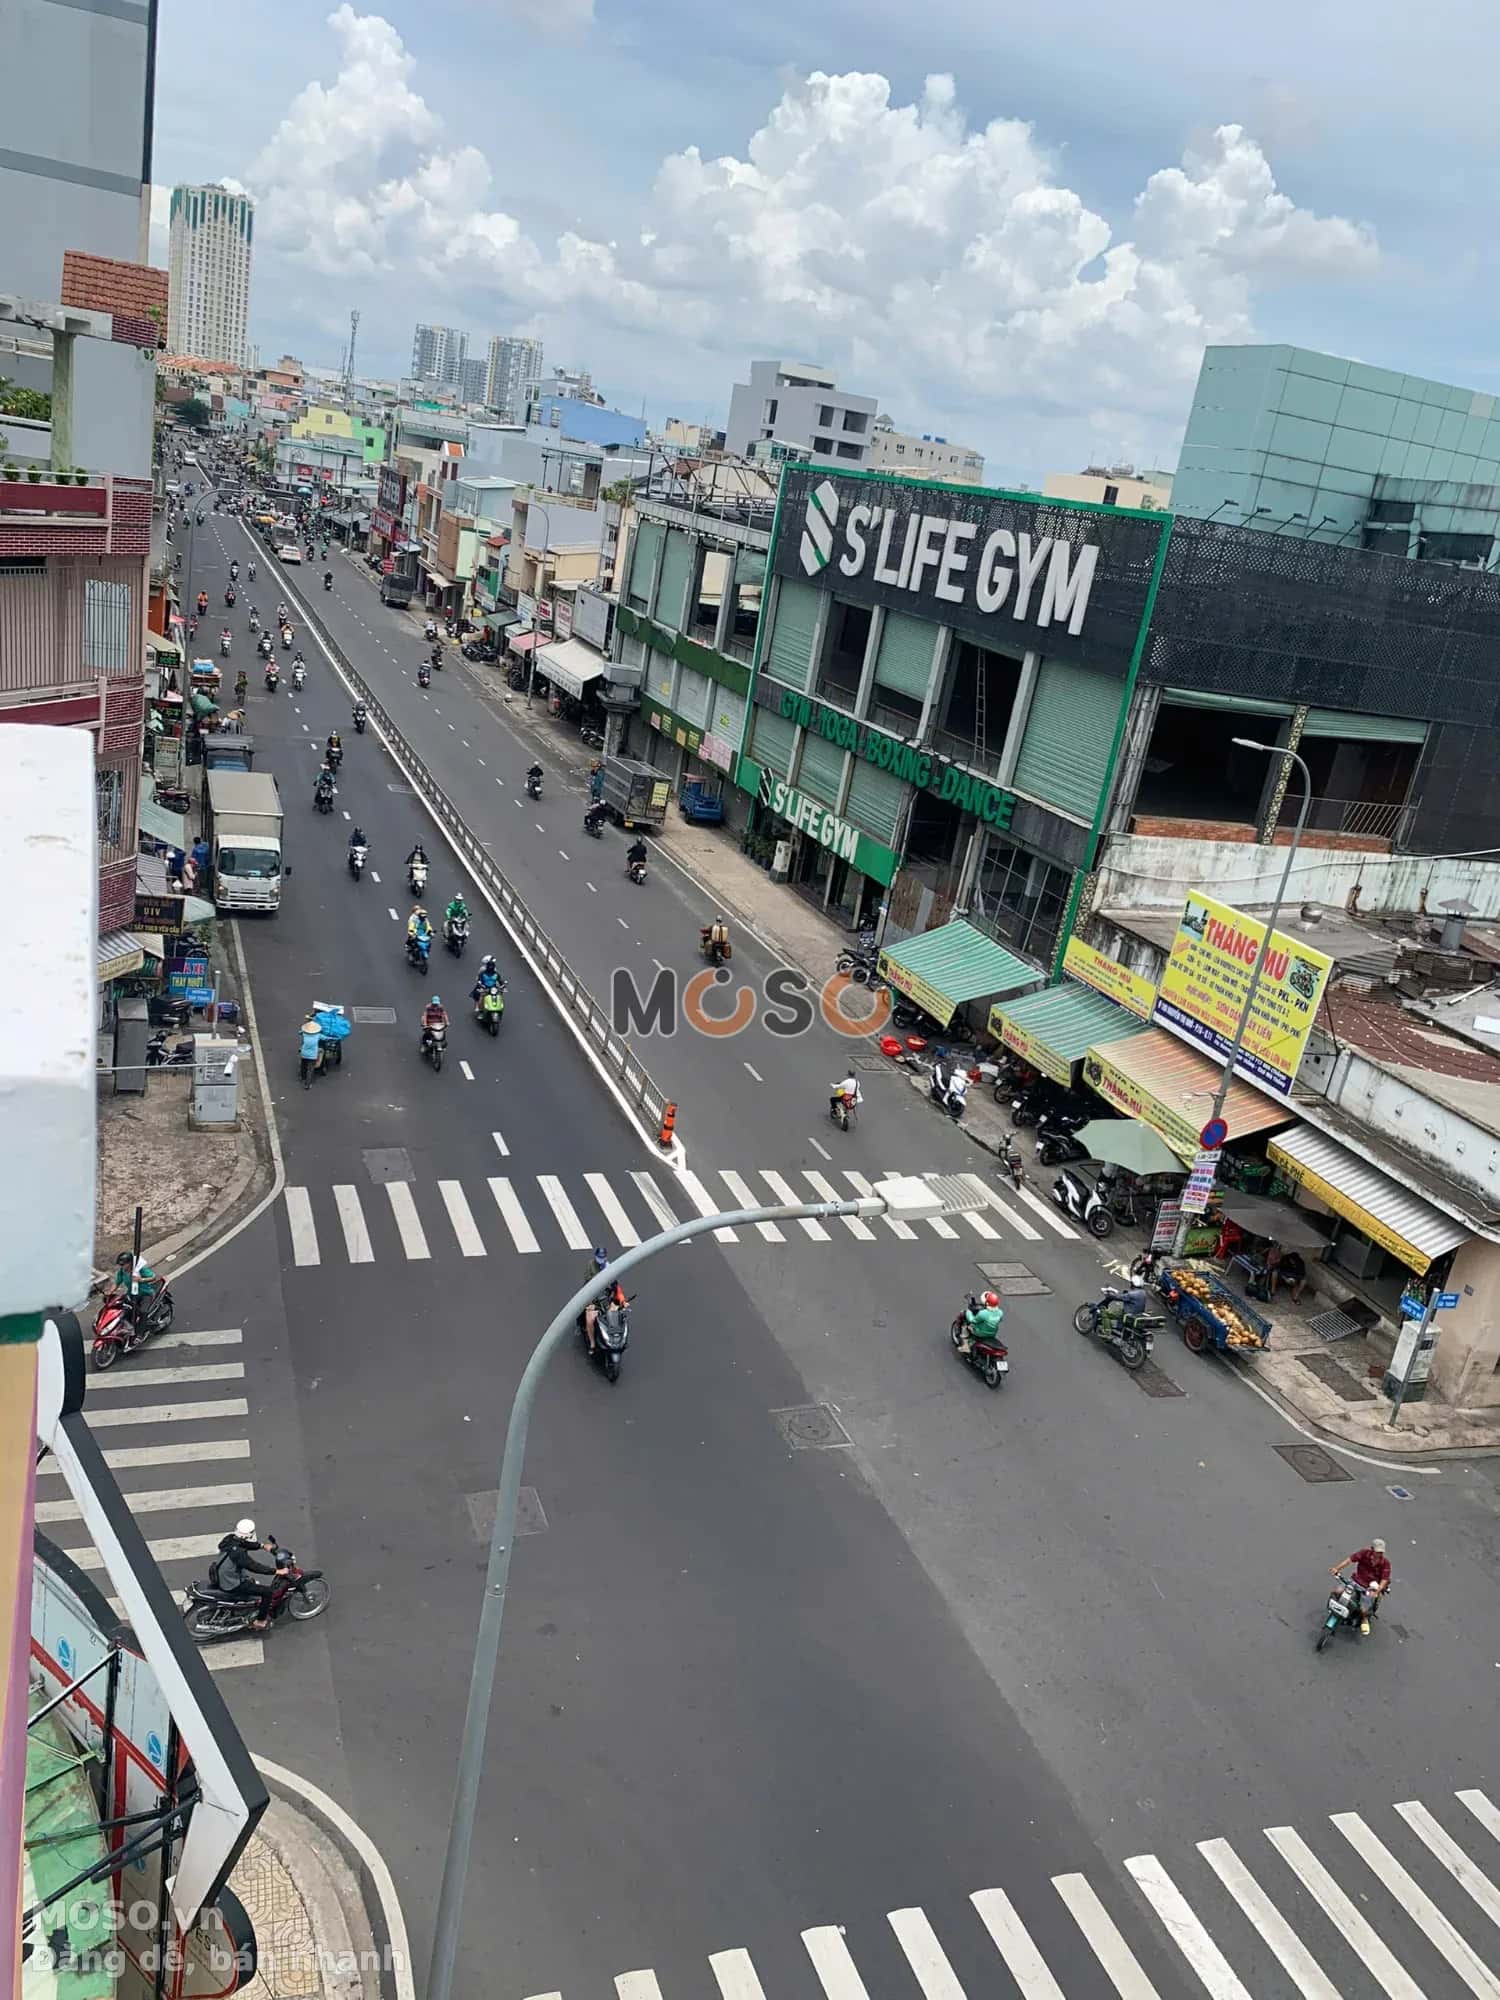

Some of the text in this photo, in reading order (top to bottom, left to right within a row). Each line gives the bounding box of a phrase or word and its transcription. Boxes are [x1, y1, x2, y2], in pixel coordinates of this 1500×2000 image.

[839, 505, 1099, 636] S'LIFE GYM
[773, 782, 860, 864] S'LIFE GYM
[780, 691, 813, 728] GYM
[819, 706, 859, 752] YOGA
[865, 728, 932, 788] BOXING
[940, 767, 1017, 830] DANCE
